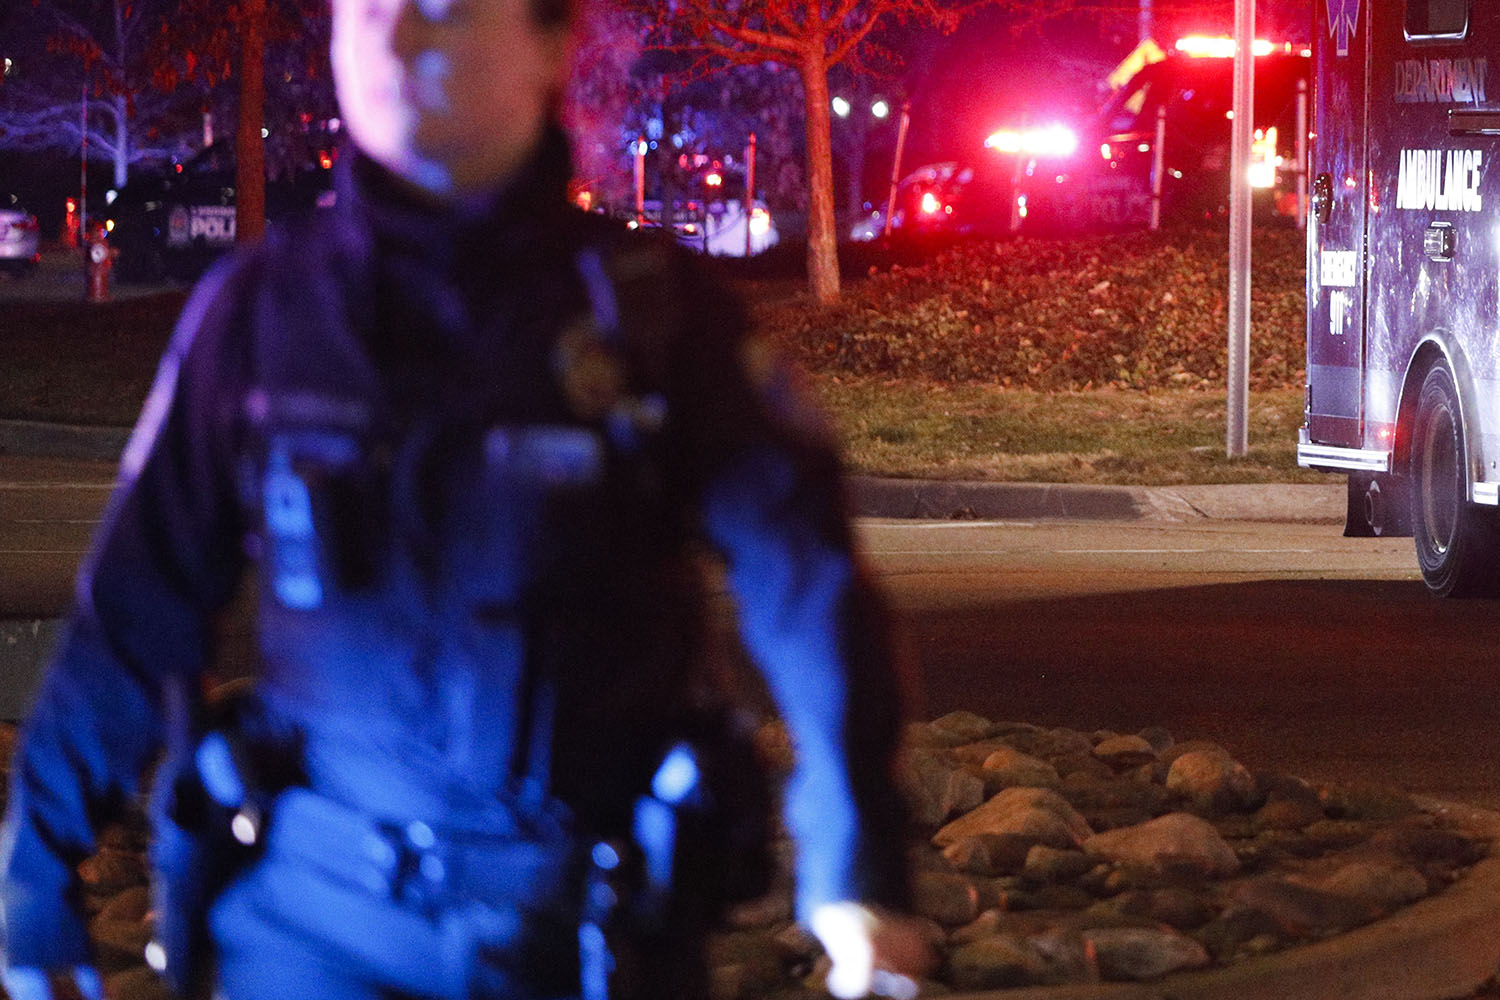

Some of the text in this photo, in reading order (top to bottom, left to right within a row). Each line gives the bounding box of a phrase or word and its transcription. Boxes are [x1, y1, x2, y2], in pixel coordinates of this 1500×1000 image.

[1393, 56, 1487, 104] DEPARTMENT
[1396, 149, 1482, 212] AMBULANCE
[190, 216, 236, 241] POLI
